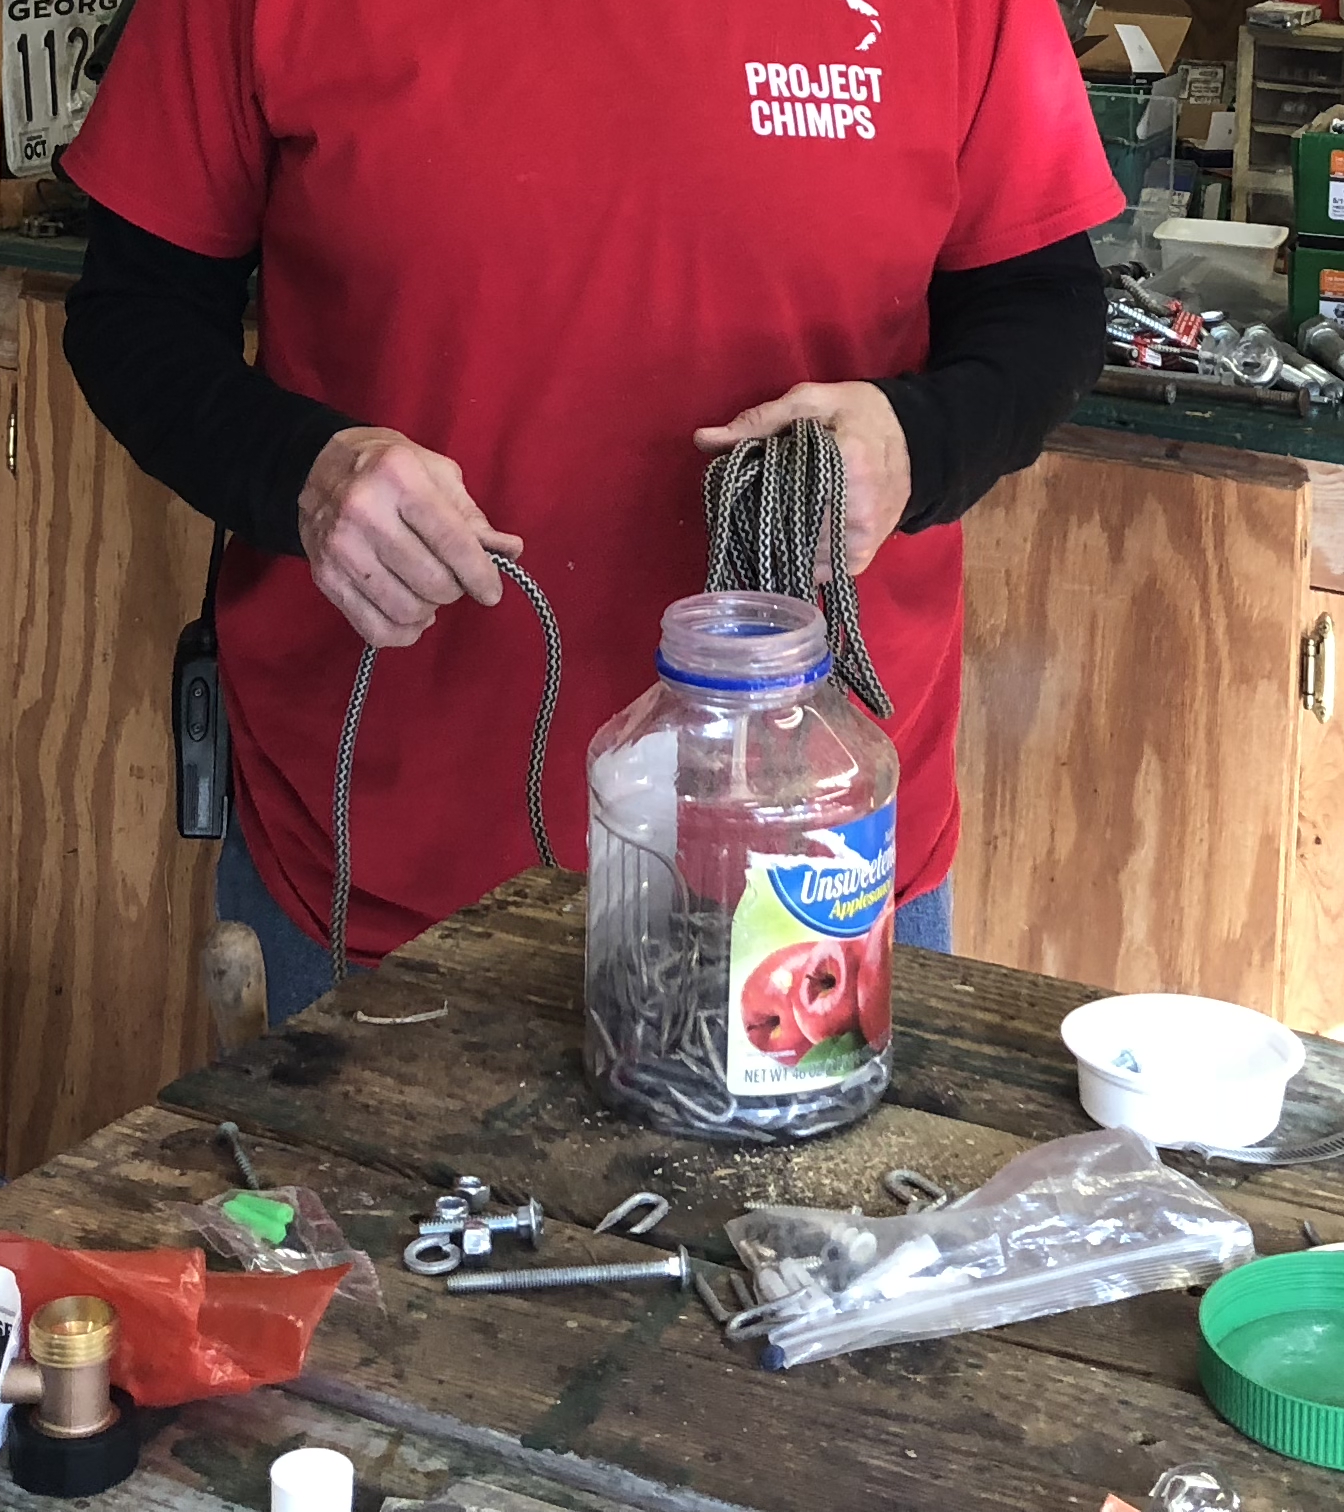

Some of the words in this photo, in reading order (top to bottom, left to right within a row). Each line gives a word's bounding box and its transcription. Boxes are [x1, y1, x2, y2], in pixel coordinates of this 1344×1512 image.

[745, 61, 883, 103] PROJECT
[750, 100, 876, 140] CHIMPS
[24, 139, 47, 161] OCT
[744, 1069, 766, 1084] NET
[769, 1066, 789, 1082] WT
